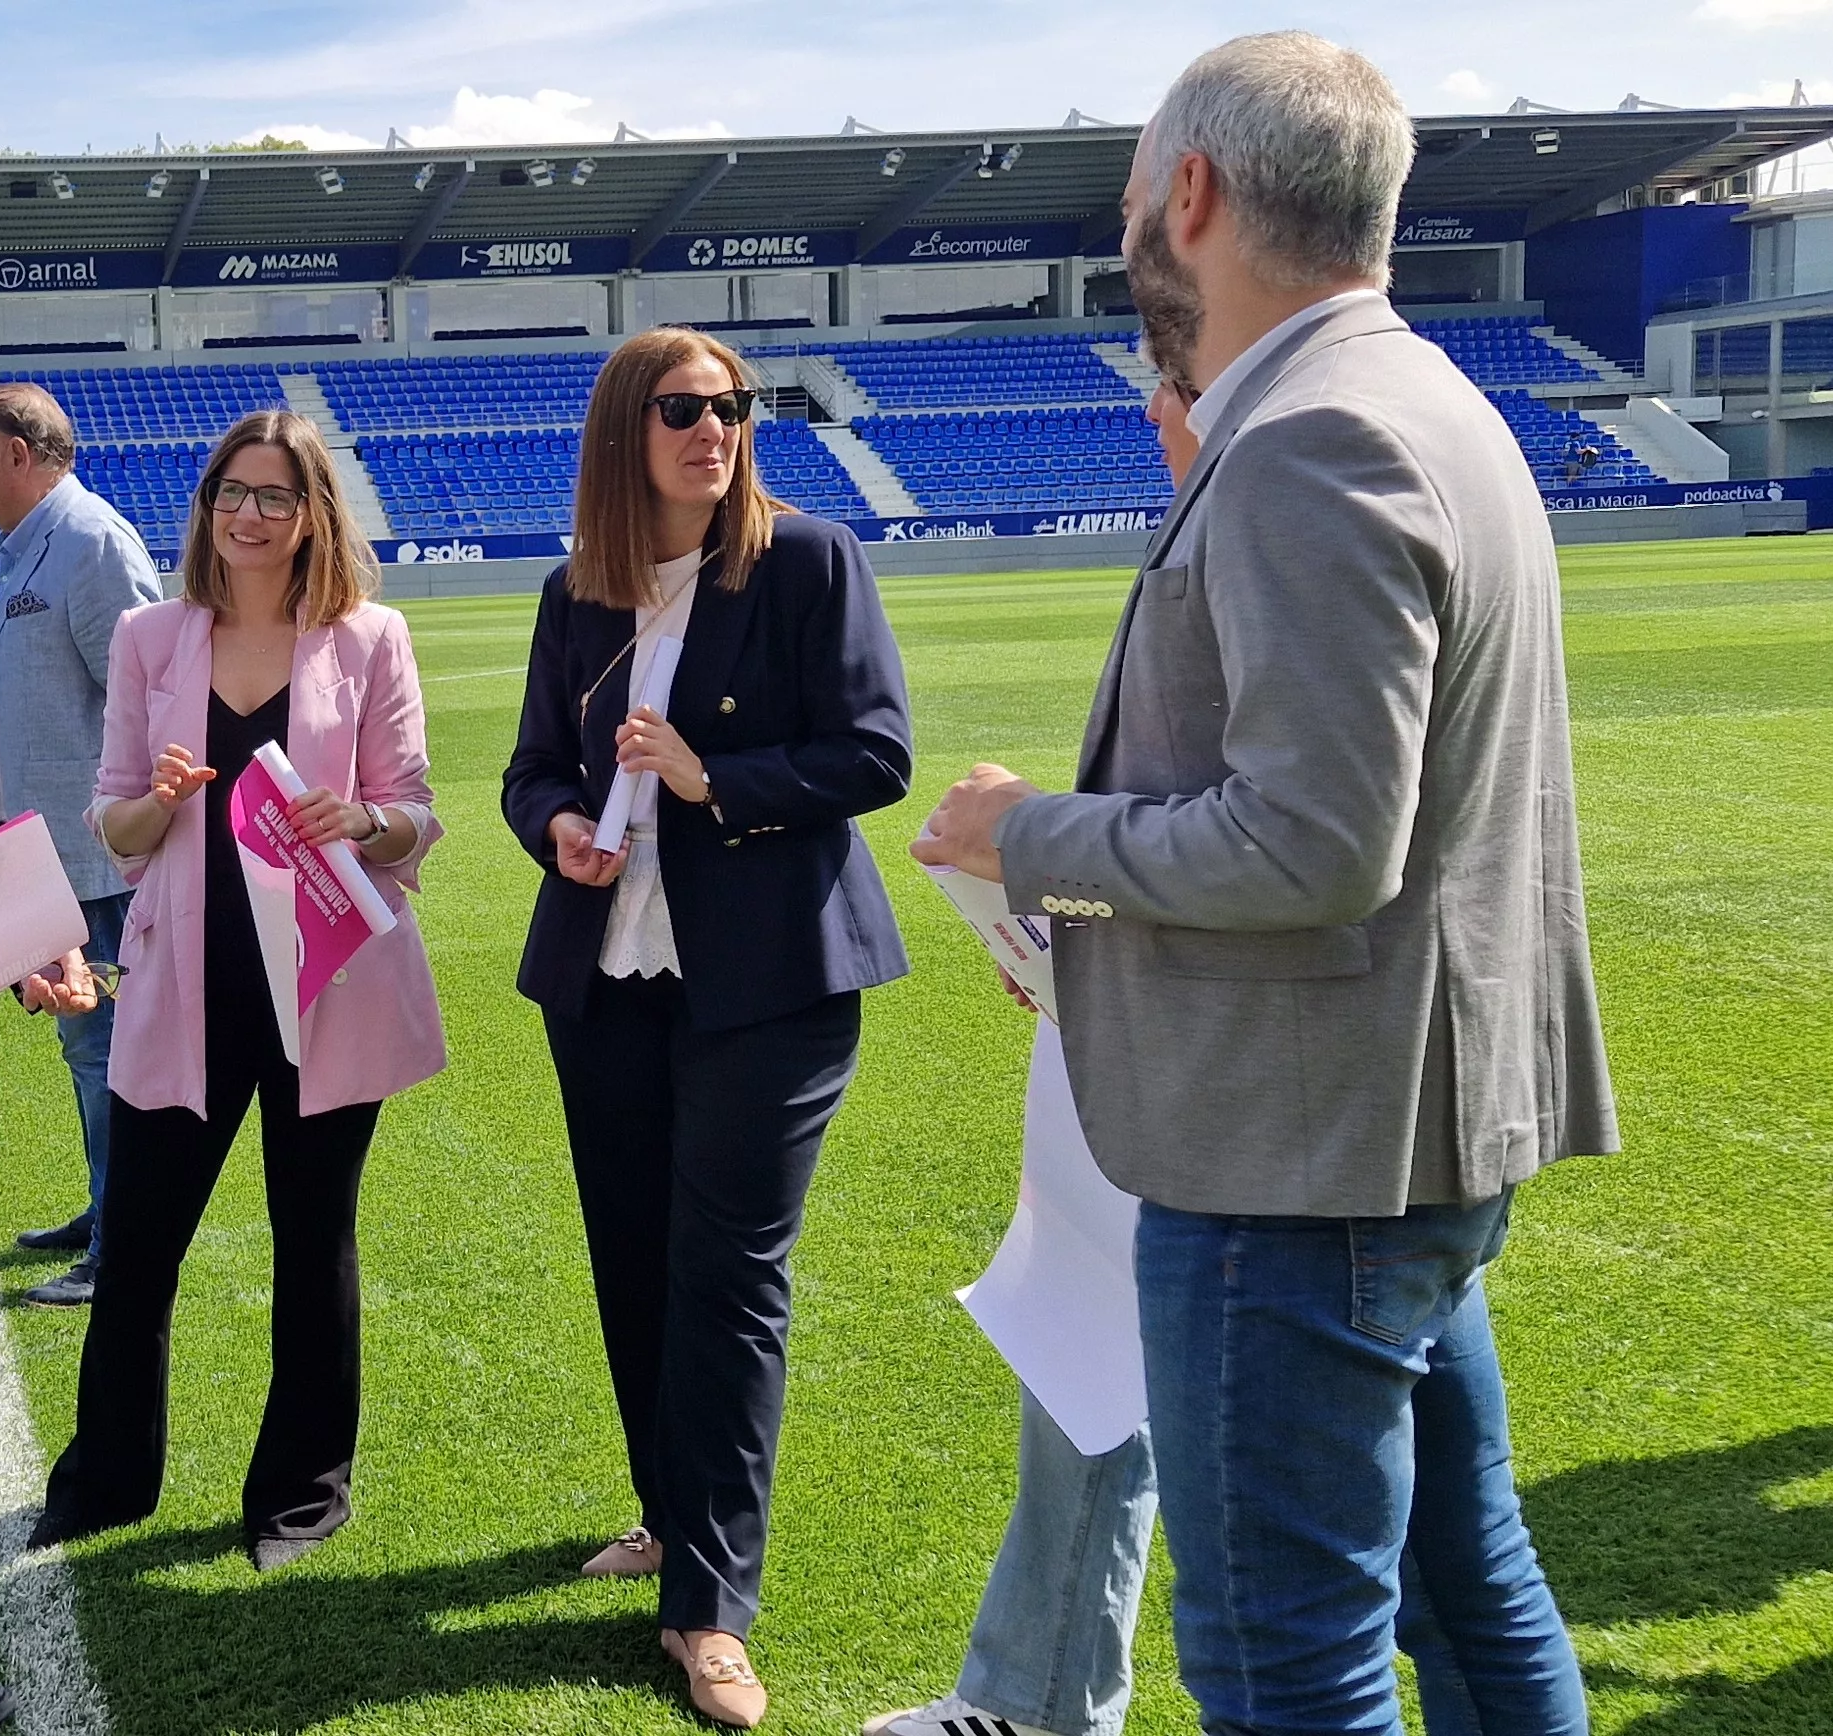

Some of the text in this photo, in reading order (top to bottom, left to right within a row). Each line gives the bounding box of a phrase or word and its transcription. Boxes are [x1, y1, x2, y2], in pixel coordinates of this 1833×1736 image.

[1417, 216, 1461, 227] Cereales
[1399, 225, 1475, 241] Arasanz
[487, 242, 572, 267] EHUSOL
[722, 235, 809, 257] DOMEC
[939, 236, 1031, 257] ecomputer
[28, 256, 97, 282] arnal
[261, 252, 339, 270] MAZANA
[721, 255, 815, 266] PLANTA DE RECICLAJE
[1684, 485, 1765, 506] podoactiva
[908, 519, 996, 540] CaixaBank
[1056, 511, 1147, 534] CLAVERIA
[423, 539, 484, 562] soka
[260, 798, 352, 916] CAMINEMOS JUNTOS
